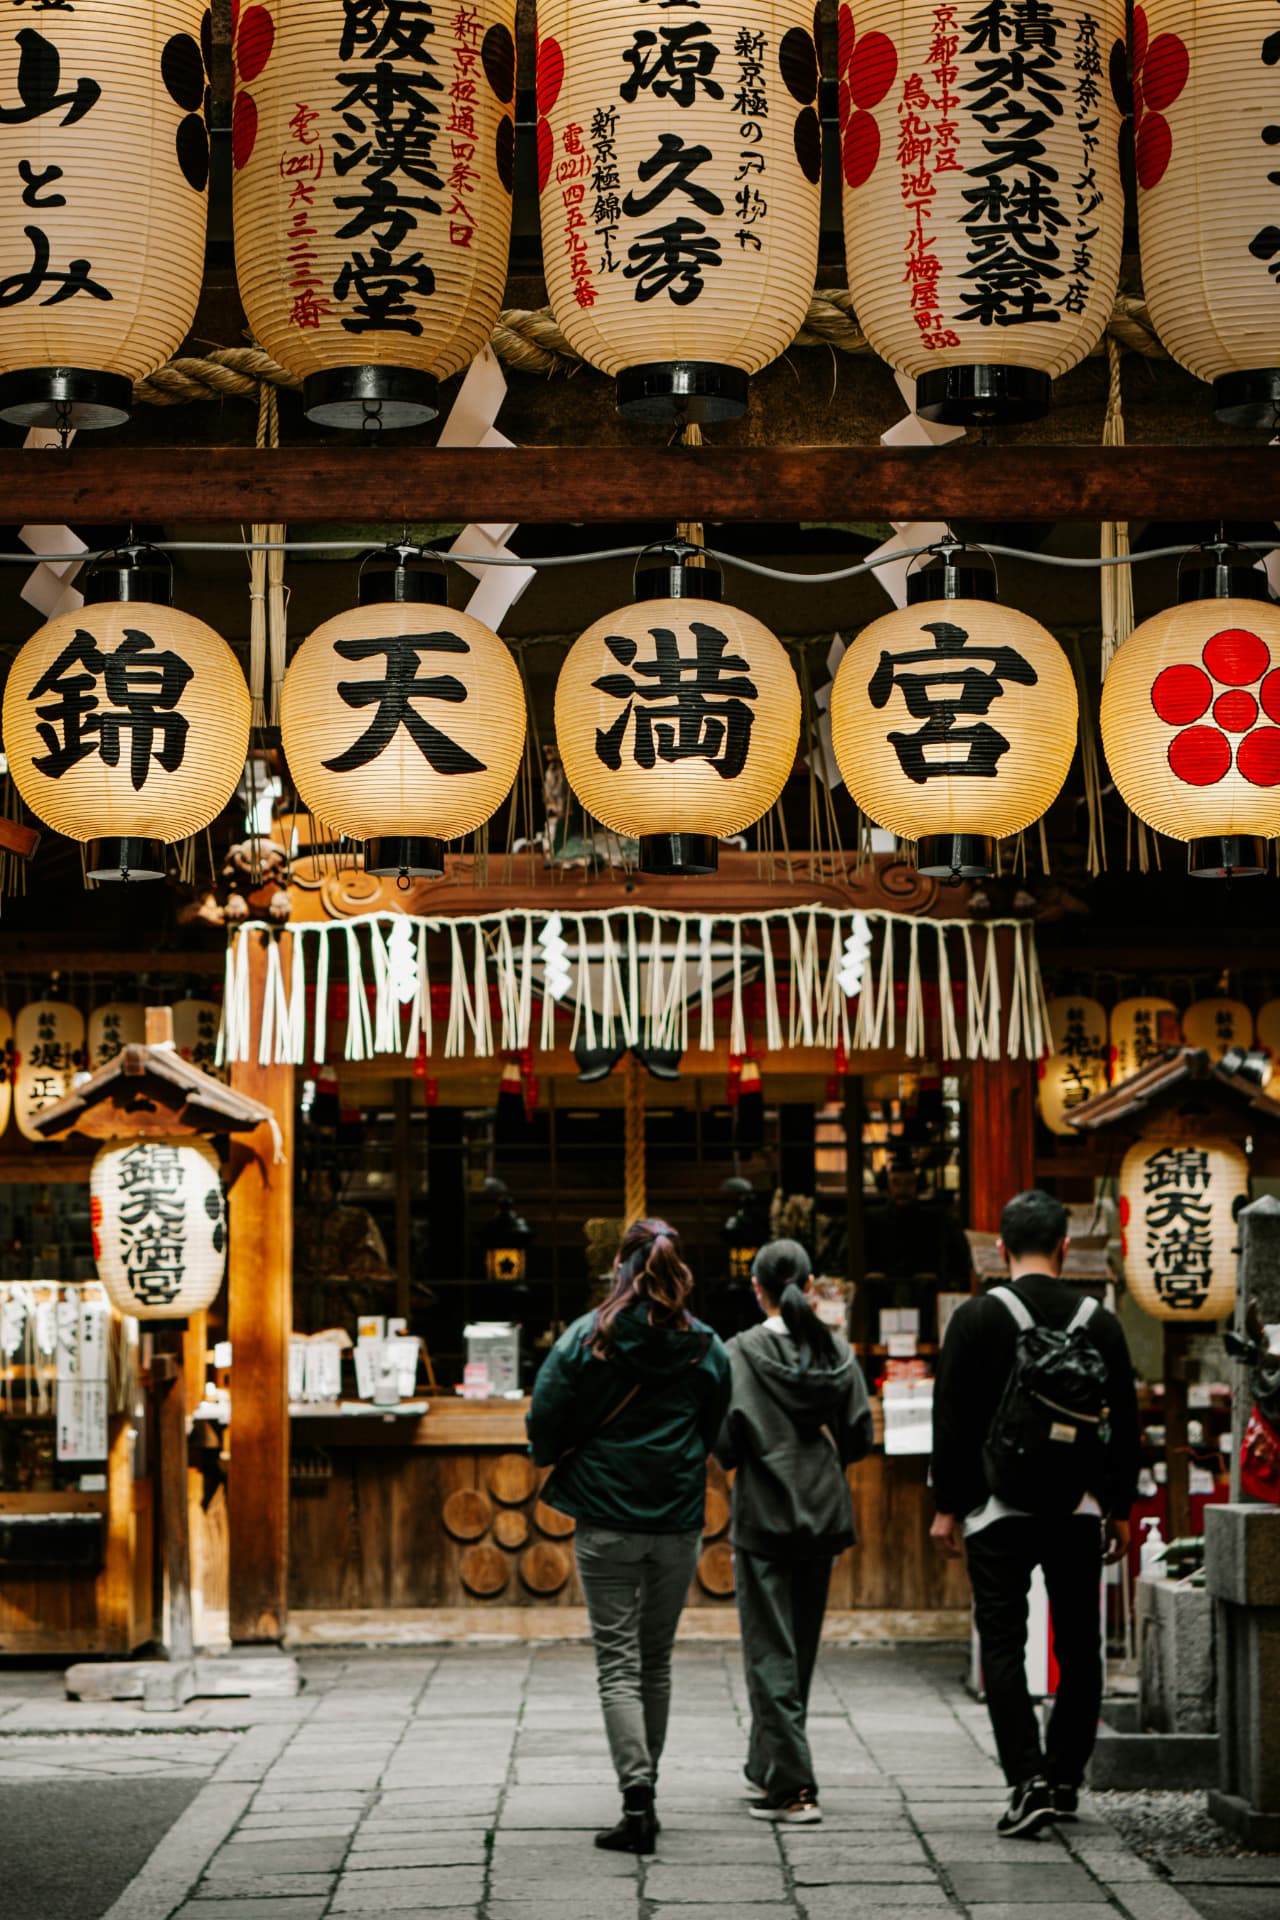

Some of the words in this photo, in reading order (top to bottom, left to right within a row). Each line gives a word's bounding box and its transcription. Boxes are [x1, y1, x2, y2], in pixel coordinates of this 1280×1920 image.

[0, 0, 114, 307] 山とみ
[332, 0, 446, 336] 阪本漢方堂
[620, 0, 725, 306] 源久秀
[923, 3, 965, 173] 京都市中京区
[952, 0, 1071, 326] 積水ハウス株式会社
[590, 105, 622, 275] 新京極錦下ル
[27, 629, 194, 791] 錦
[320, 631, 488, 774] 天
[591, 622, 758, 780] 満
[868, 622, 1038, 784] 宮
[118, 1143, 187, 1305] 錦天満宮
[1143, 1147, 1214, 1310] 錦天満宮
